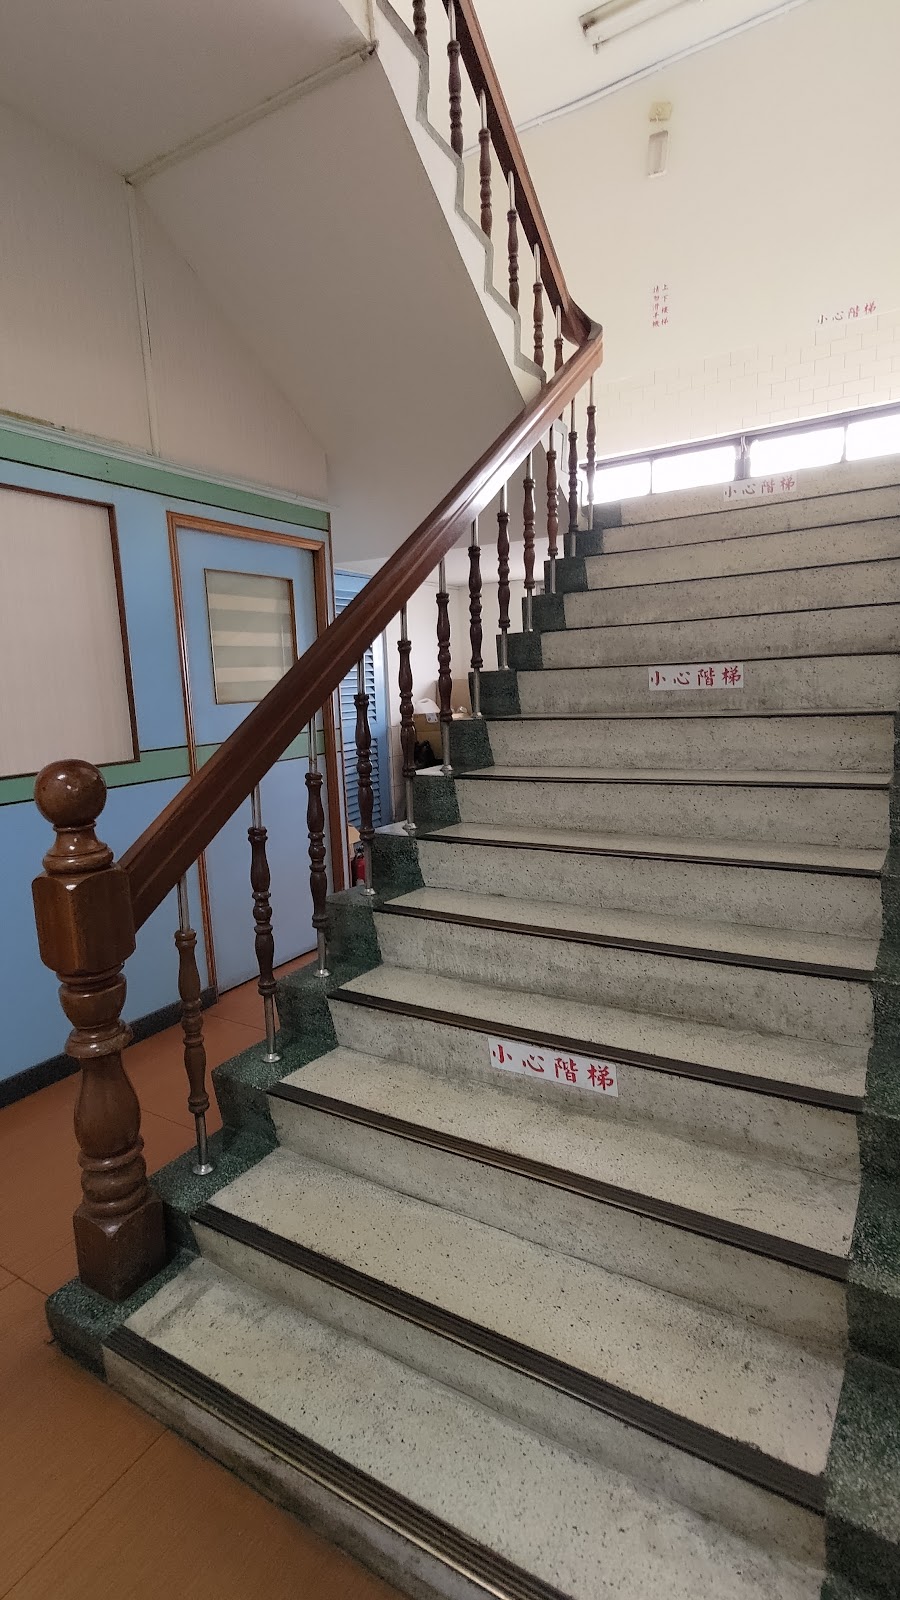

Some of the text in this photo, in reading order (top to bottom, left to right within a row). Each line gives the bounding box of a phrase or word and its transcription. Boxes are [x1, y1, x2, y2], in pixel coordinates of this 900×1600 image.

[817, 300, 877, 325] 小心階梯
[724, 475, 795, 498] 小心階梯
[650, 665, 741, 687] 小心階梯
[492, 1044, 614, 1091] 小心階梯
